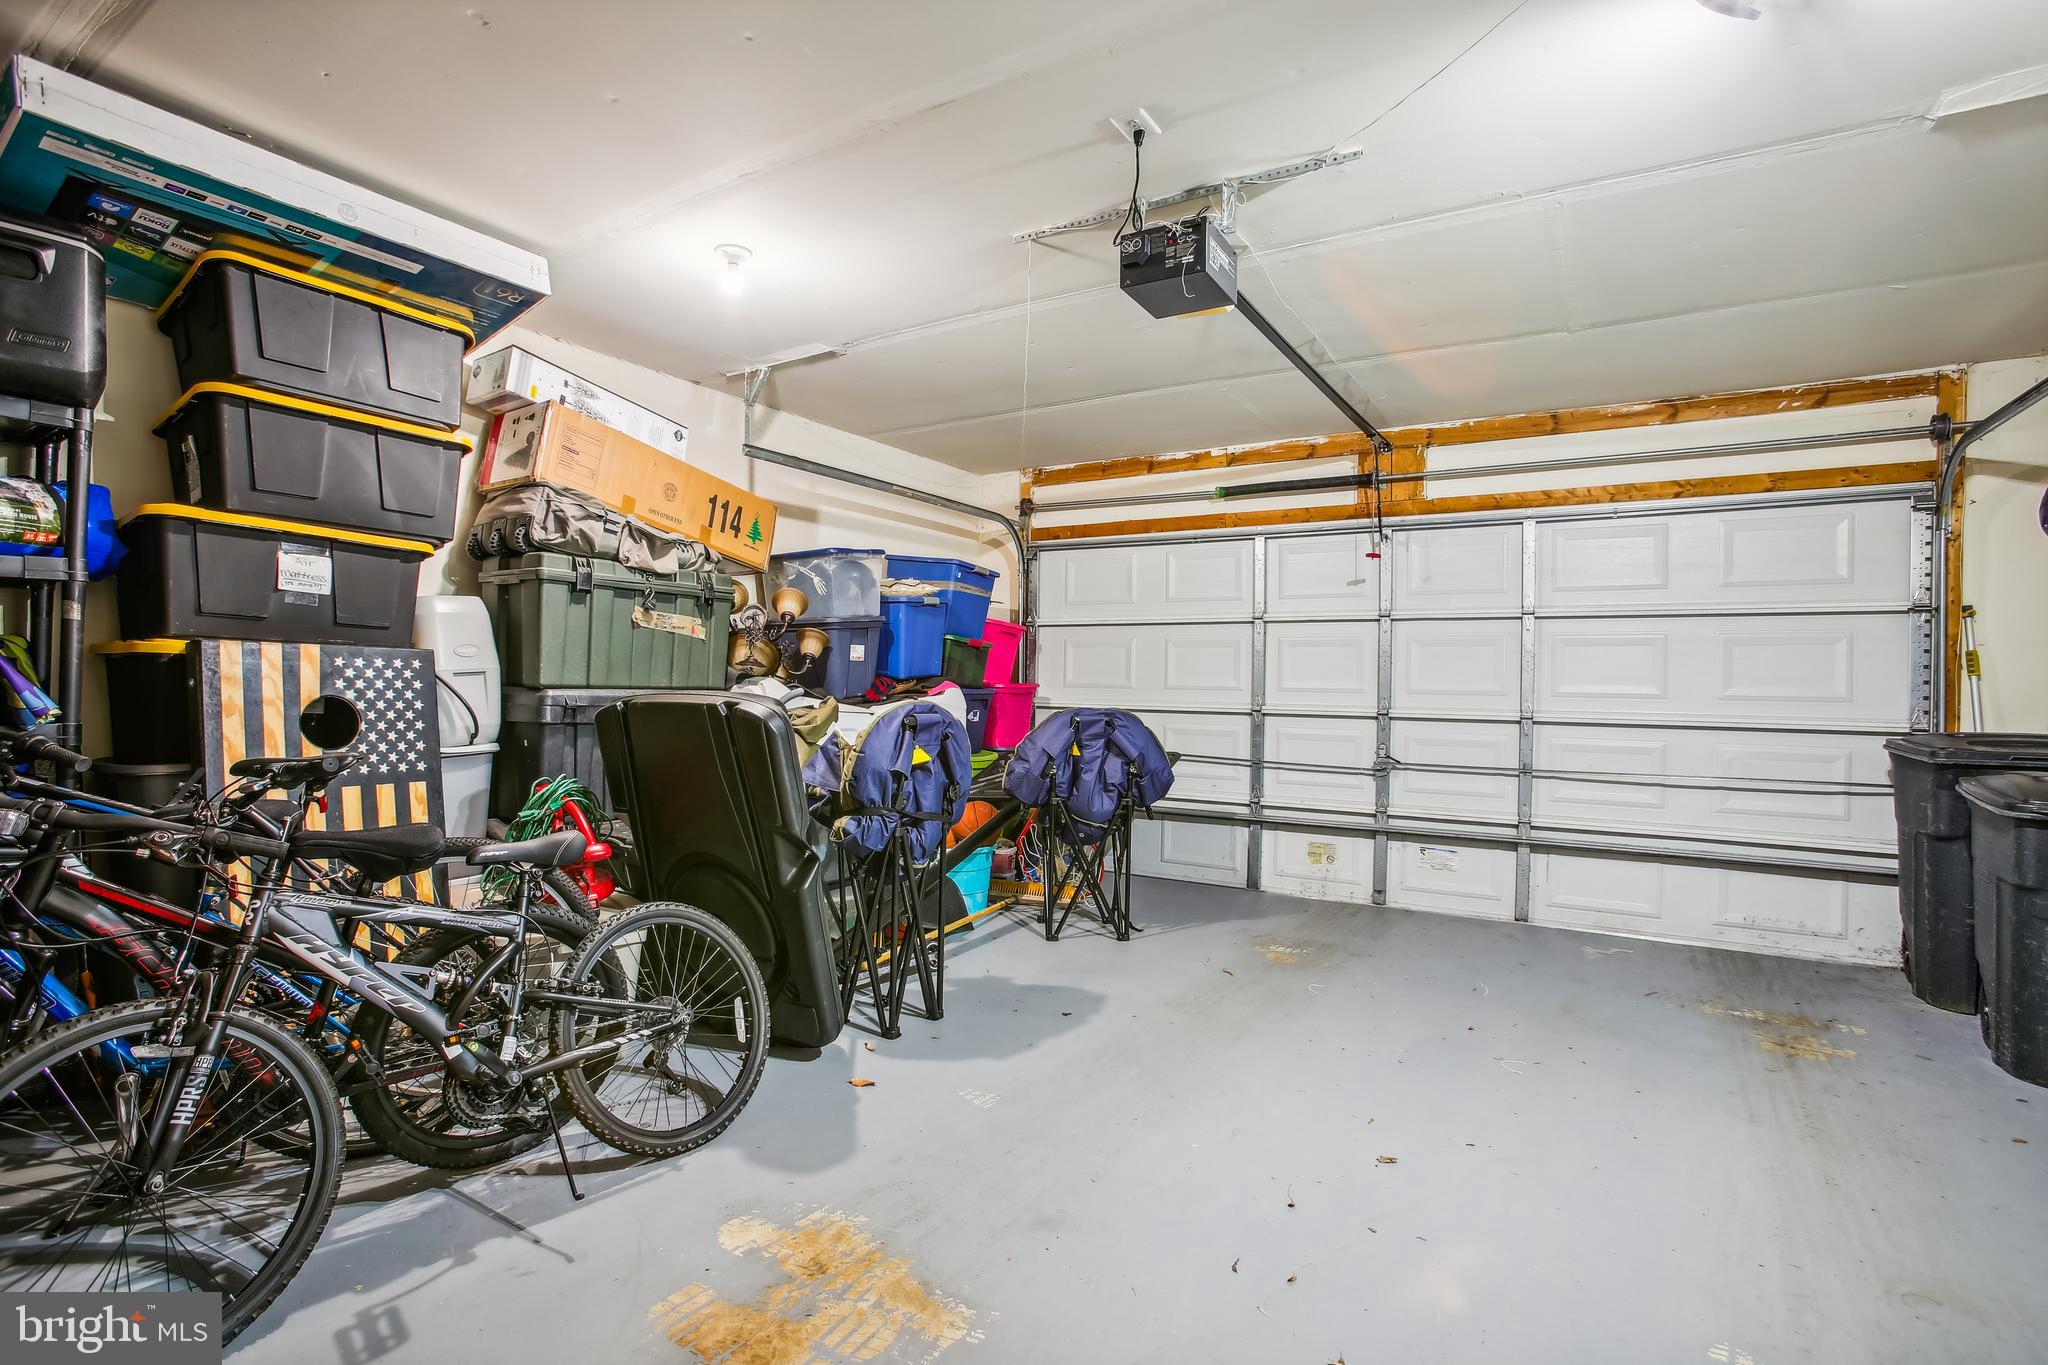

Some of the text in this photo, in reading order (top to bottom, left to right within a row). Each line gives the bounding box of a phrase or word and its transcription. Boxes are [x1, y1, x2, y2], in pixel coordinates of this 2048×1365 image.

[139, 215, 170, 230] Roku
[170, 242, 200, 256] NETFLIX
[648, 507, 683, 525] OPEN OTHER END
[707, 494, 743, 539] 114
[170, 1075, 208, 1125] HPRS
